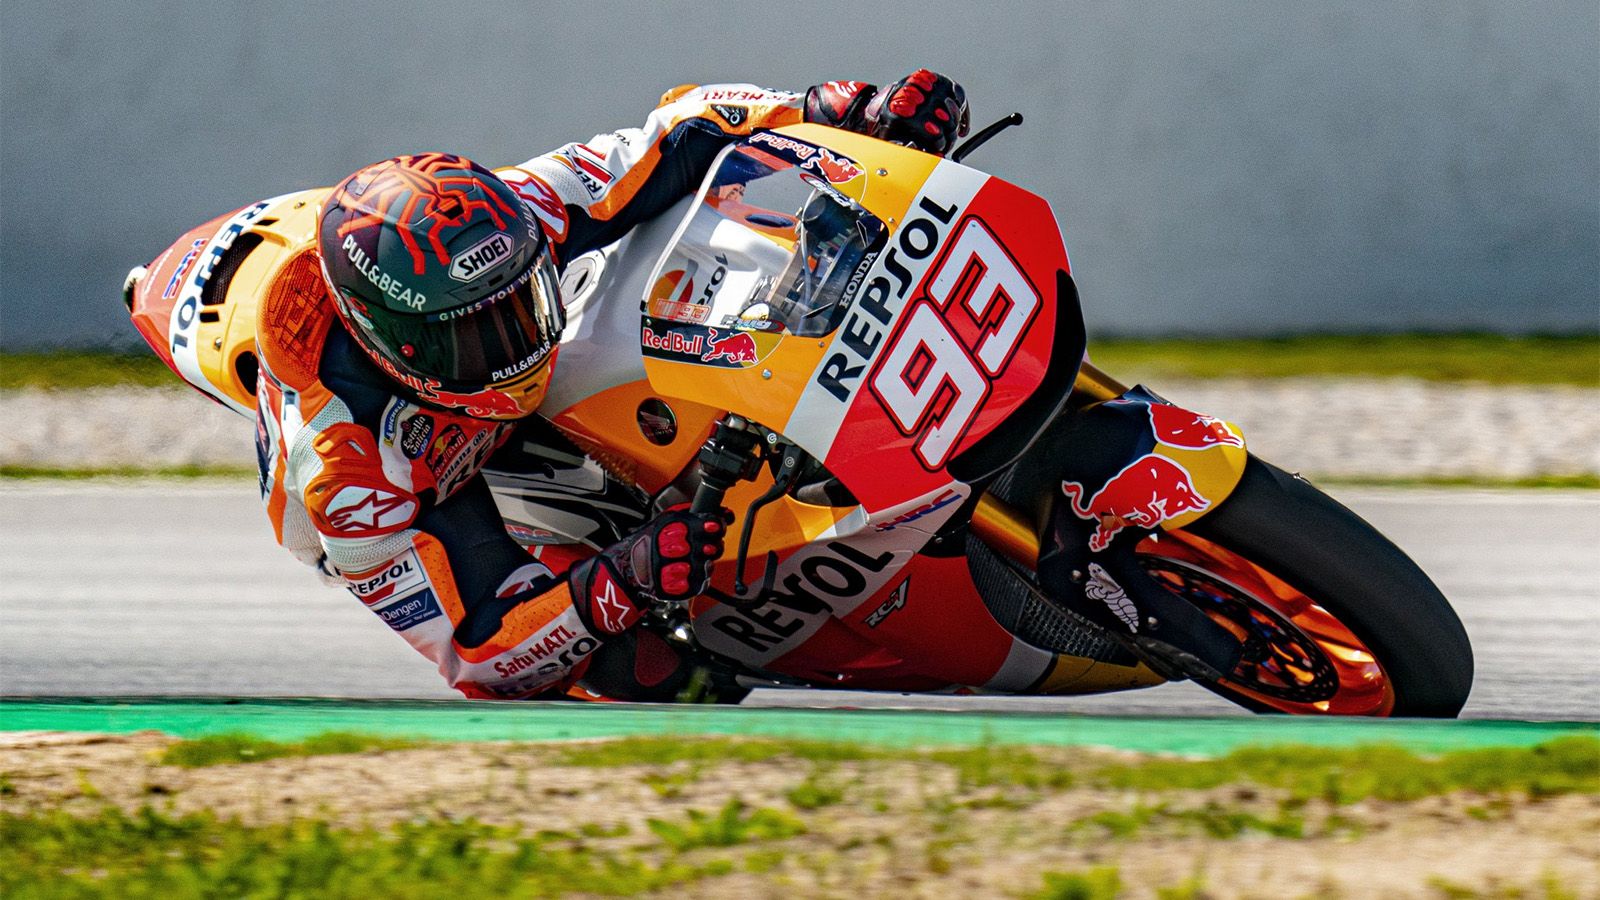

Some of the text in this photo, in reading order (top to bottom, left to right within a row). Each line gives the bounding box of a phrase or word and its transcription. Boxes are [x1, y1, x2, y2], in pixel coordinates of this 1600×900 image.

[342, 234, 427, 311] PULL&BEAR
[457, 236, 509, 277] SHOEI
[816, 195, 958, 403] REPSOL
[838, 251, 878, 309] HONDA
[440, 302, 482, 321] GIVES
[488, 284, 515, 304] YOU
[491, 341, 551, 381] PULL&BEAR
[869, 215, 1042, 471] 93
[403, 416, 426, 450] Estrella
[410, 424, 431, 455] Galicia
[379, 600, 421, 621] Dengen
